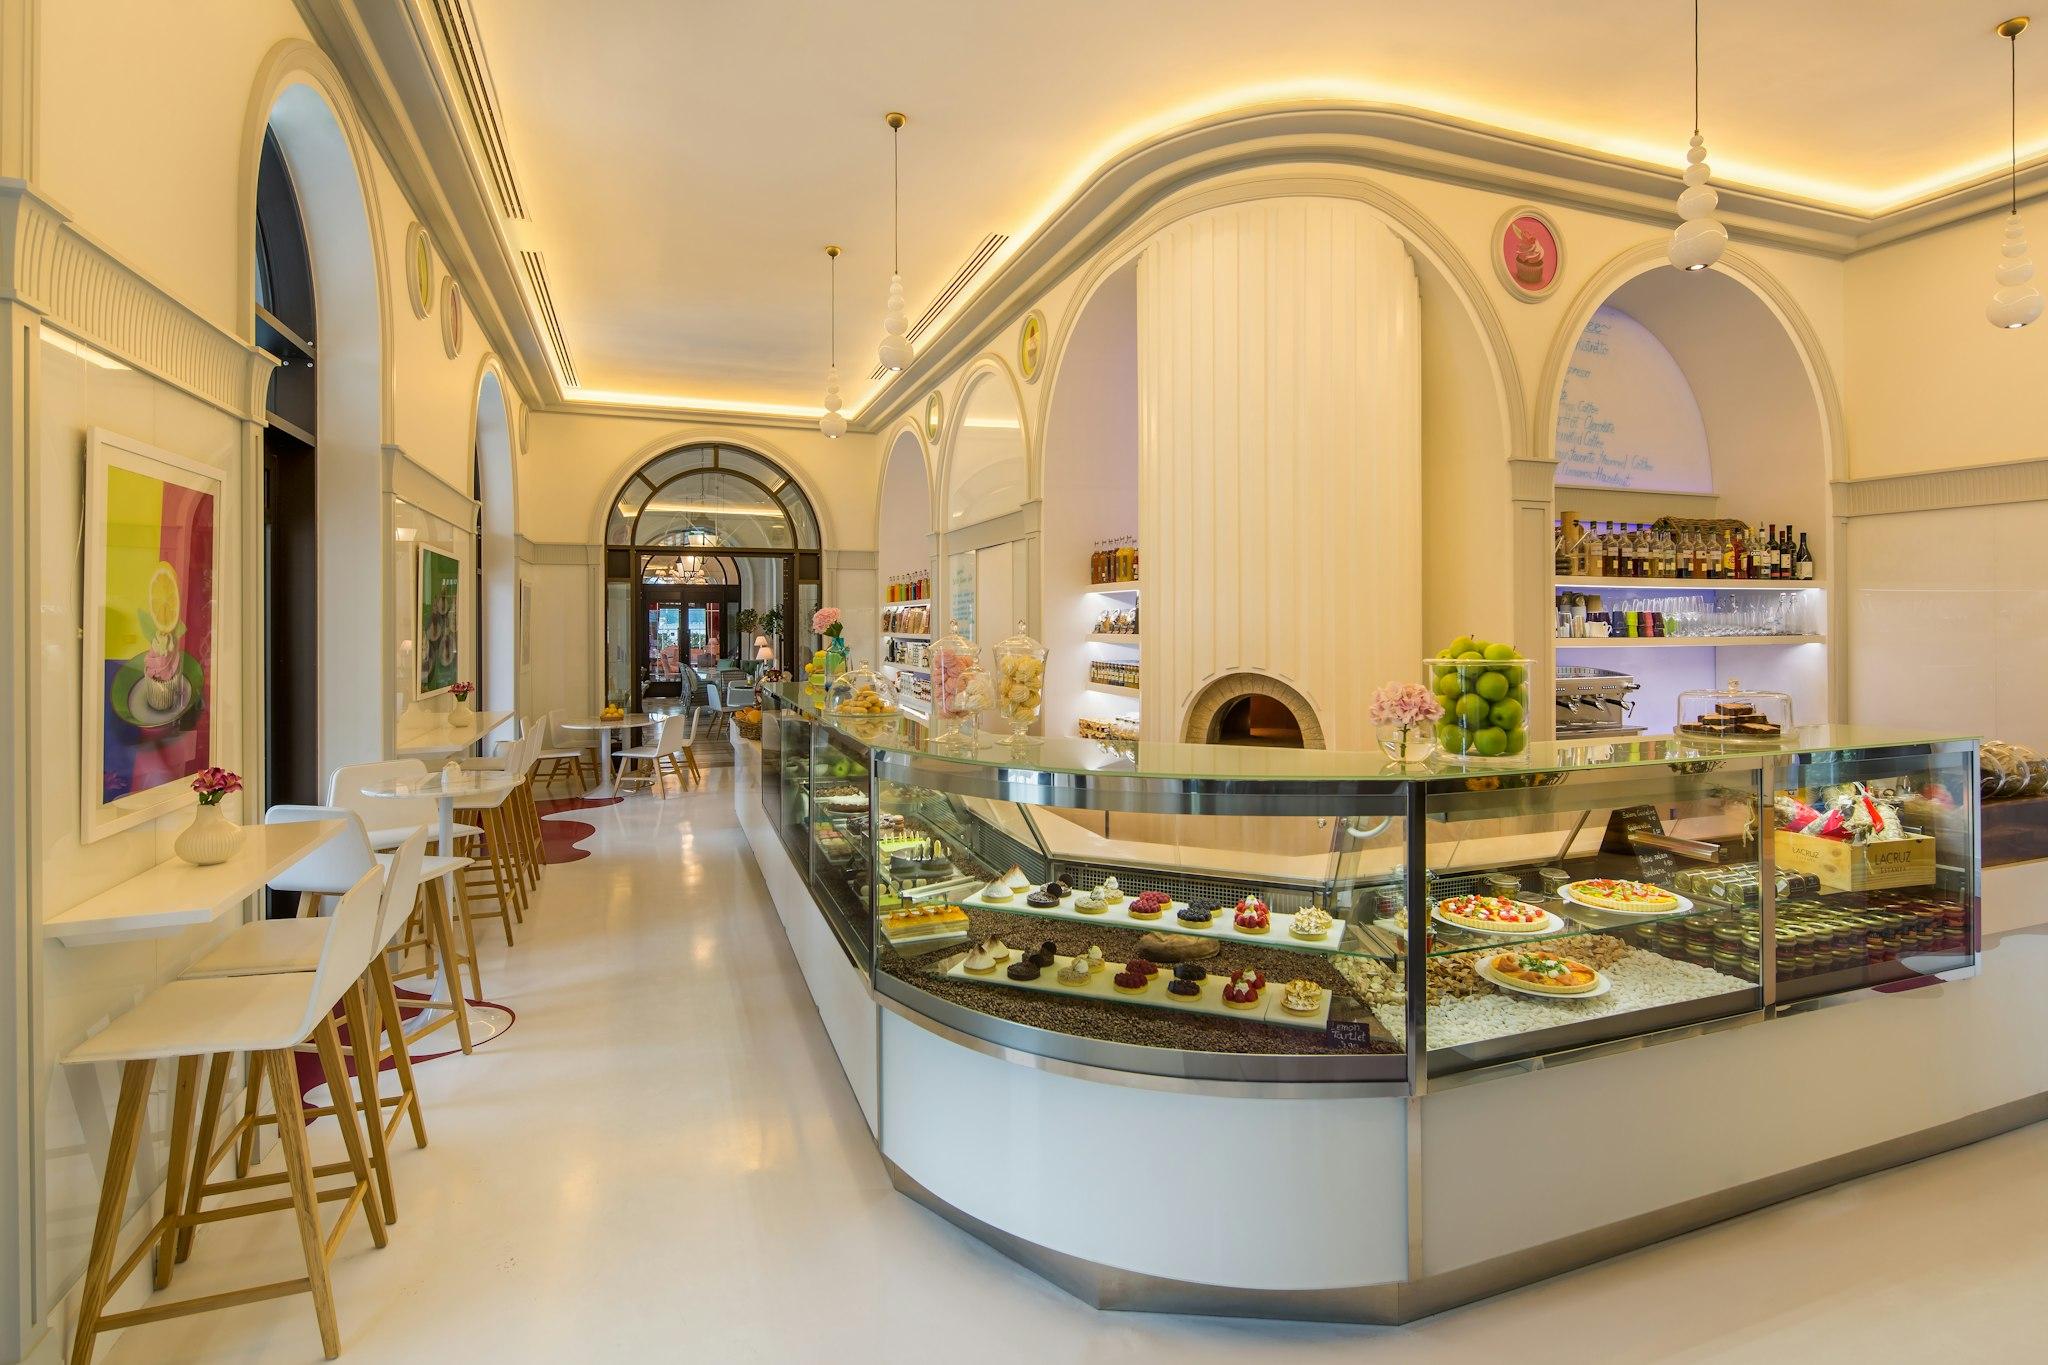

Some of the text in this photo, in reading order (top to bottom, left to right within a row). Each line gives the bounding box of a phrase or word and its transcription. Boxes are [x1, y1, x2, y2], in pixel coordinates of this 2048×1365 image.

[1792, 847, 1819, 858] LACRUZ
[1874, 850, 1911, 865] LACRUZ
[1330, 1021, 1360, 1031] Lemon
